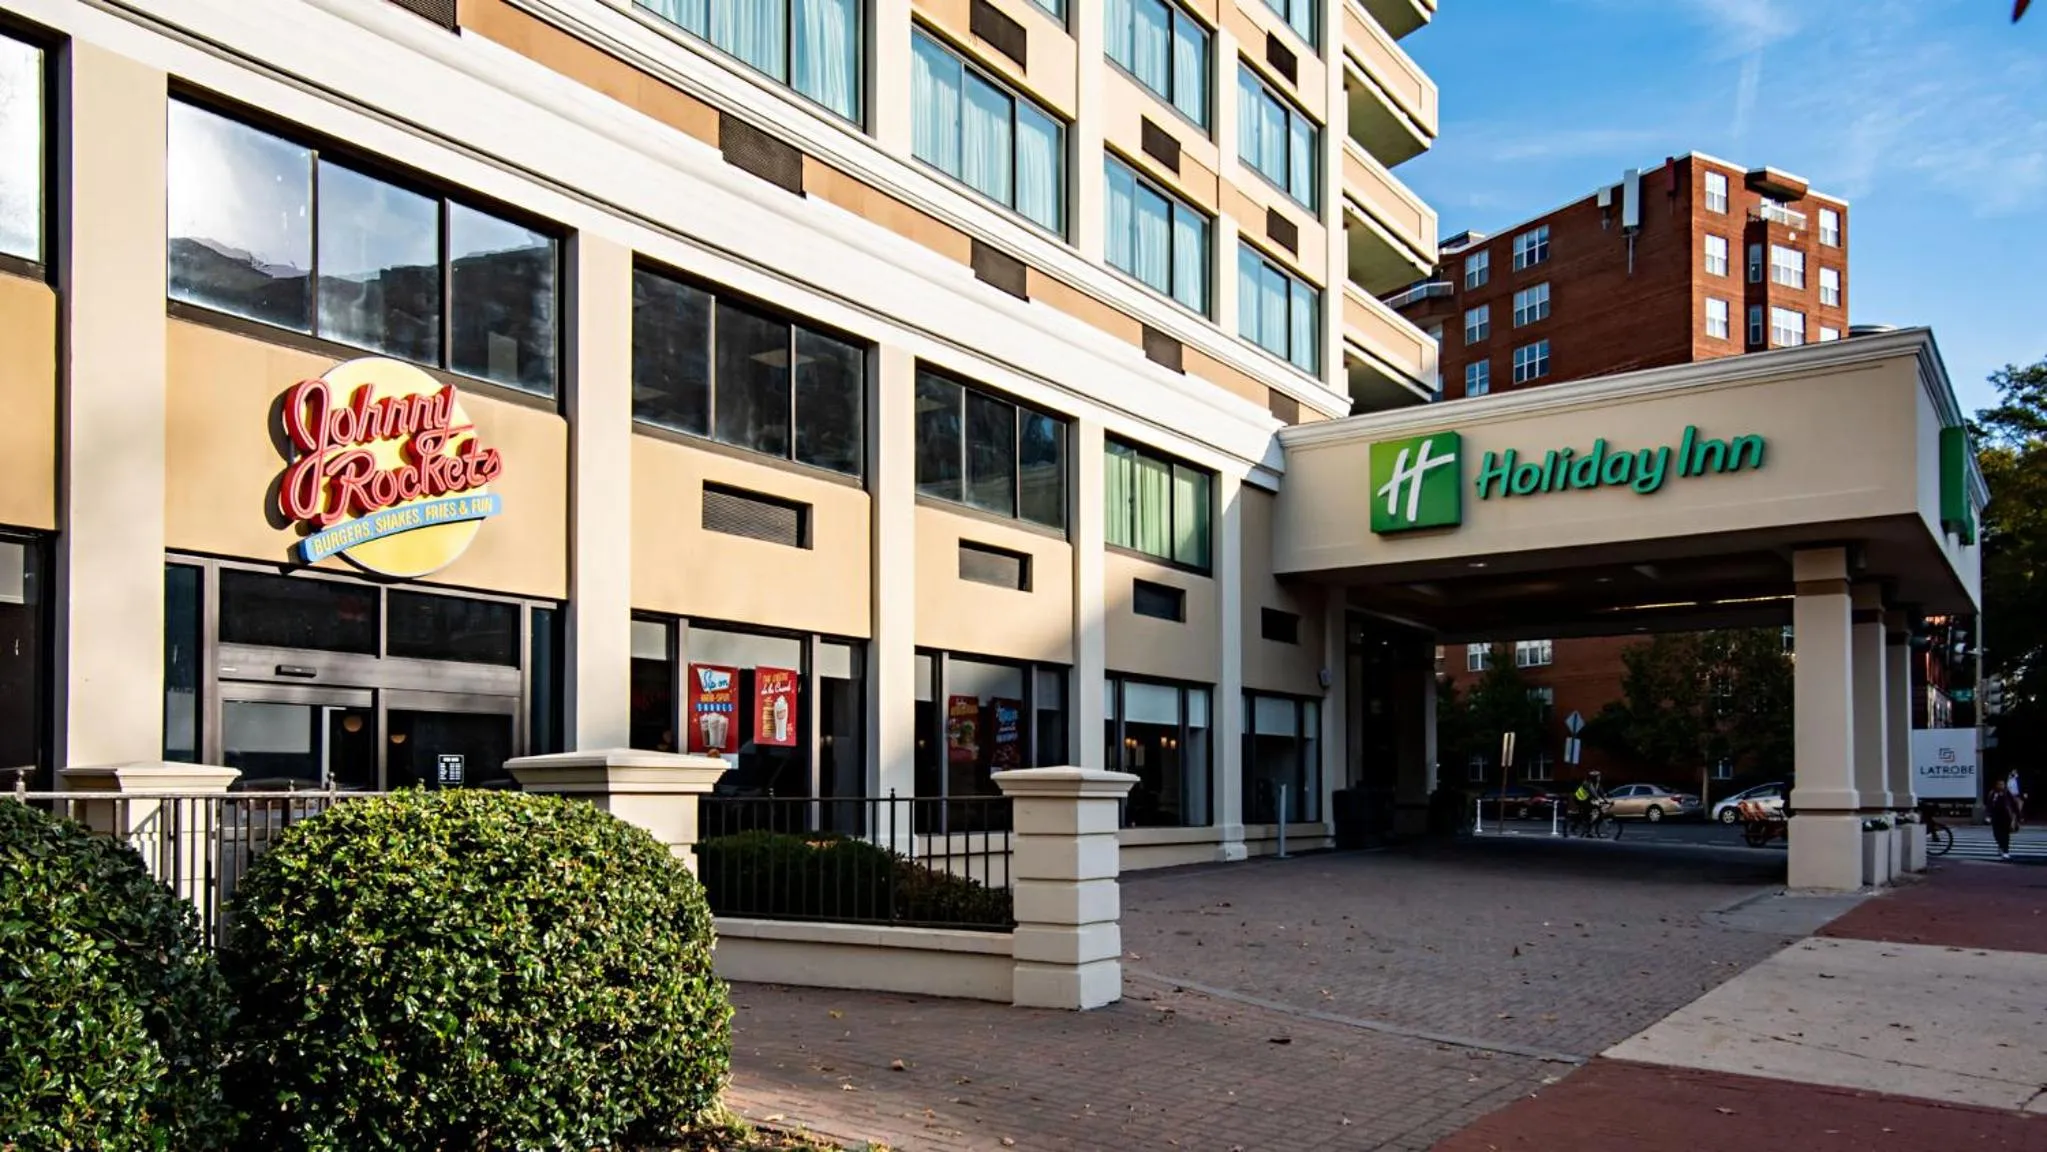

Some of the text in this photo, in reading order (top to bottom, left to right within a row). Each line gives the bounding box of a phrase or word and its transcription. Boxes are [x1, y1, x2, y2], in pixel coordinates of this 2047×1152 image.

[280, 377, 477, 520] Johnny
[321, 438, 503, 525] Rockets
[1475, 424, 1766, 500] Holiday Inn
[425, 502, 456, 522] FRIES
[458, 502, 468, 517] &
[471, 498, 493, 514] FUN
[1920, 765, 1975, 775] LATROBE
